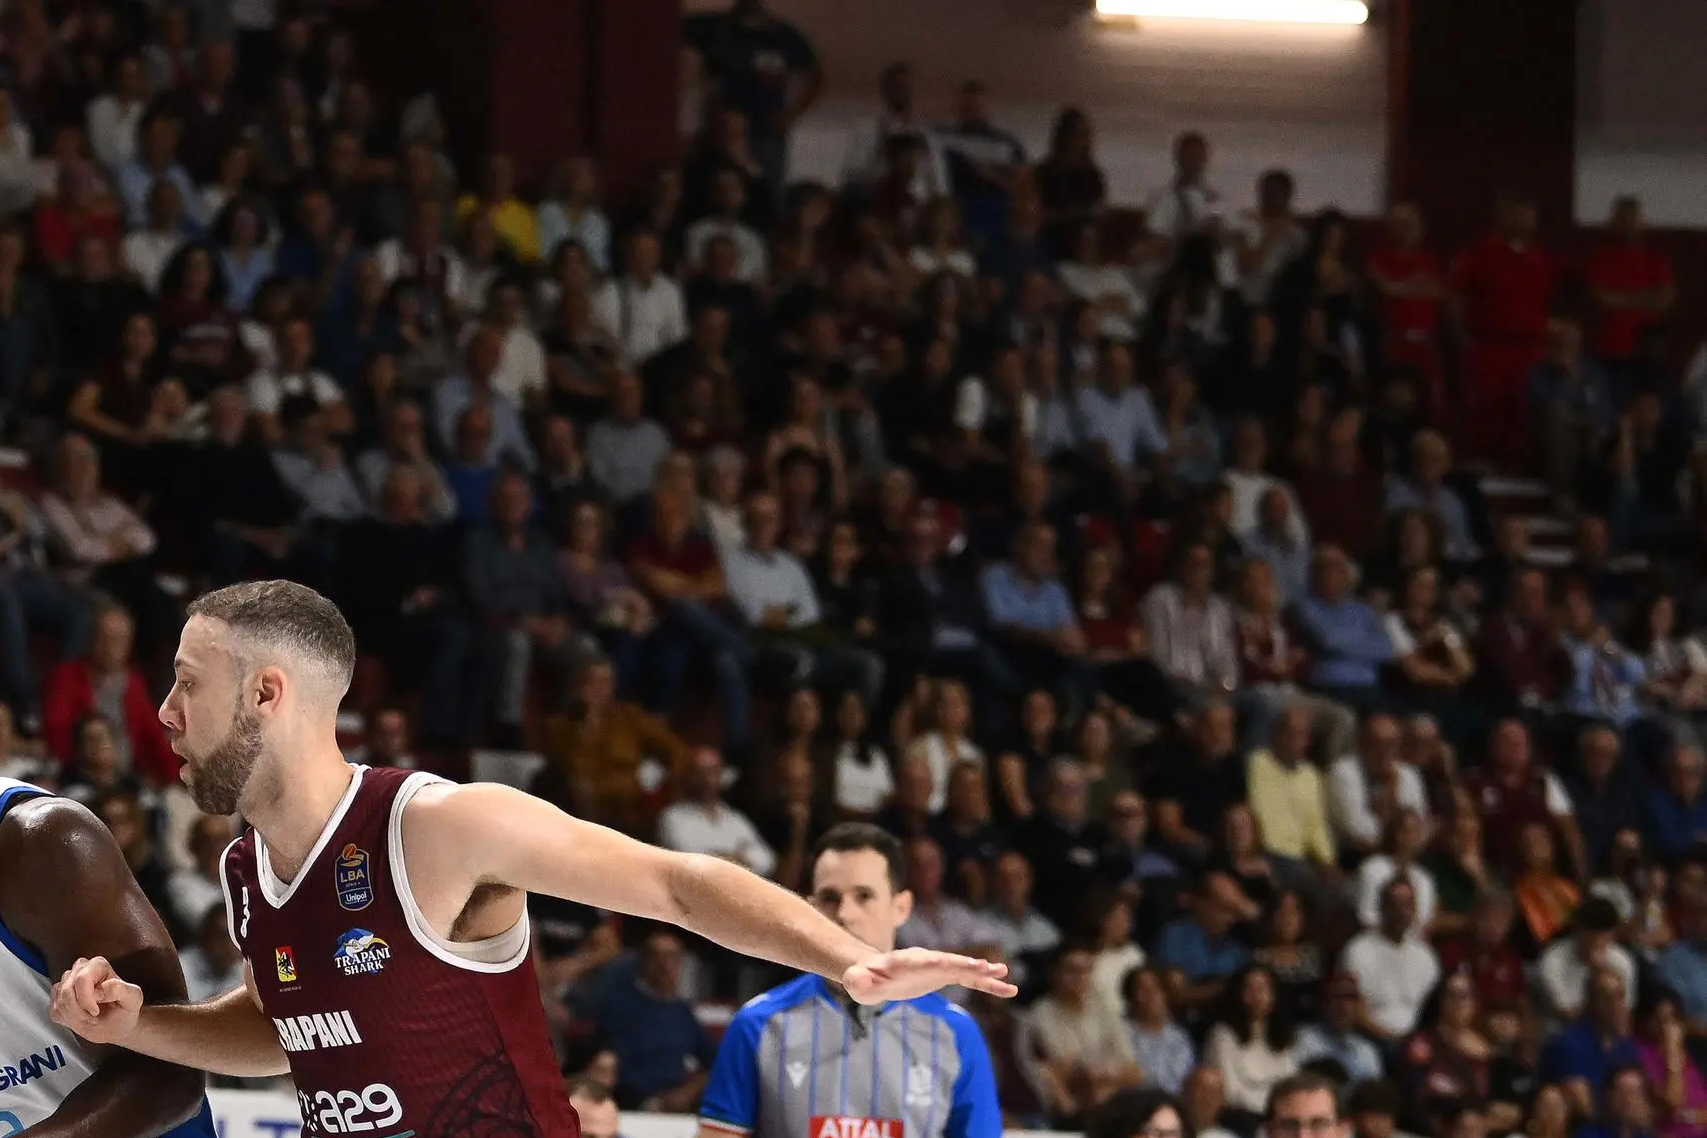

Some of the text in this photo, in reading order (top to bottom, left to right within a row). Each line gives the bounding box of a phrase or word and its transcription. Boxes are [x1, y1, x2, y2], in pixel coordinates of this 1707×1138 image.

[341, 872, 365, 883] LBA
[345, 891, 368, 904] Unipol
[334, 947, 391, 969] TRAPANI
[344, 960, 384, 976] SHARK
